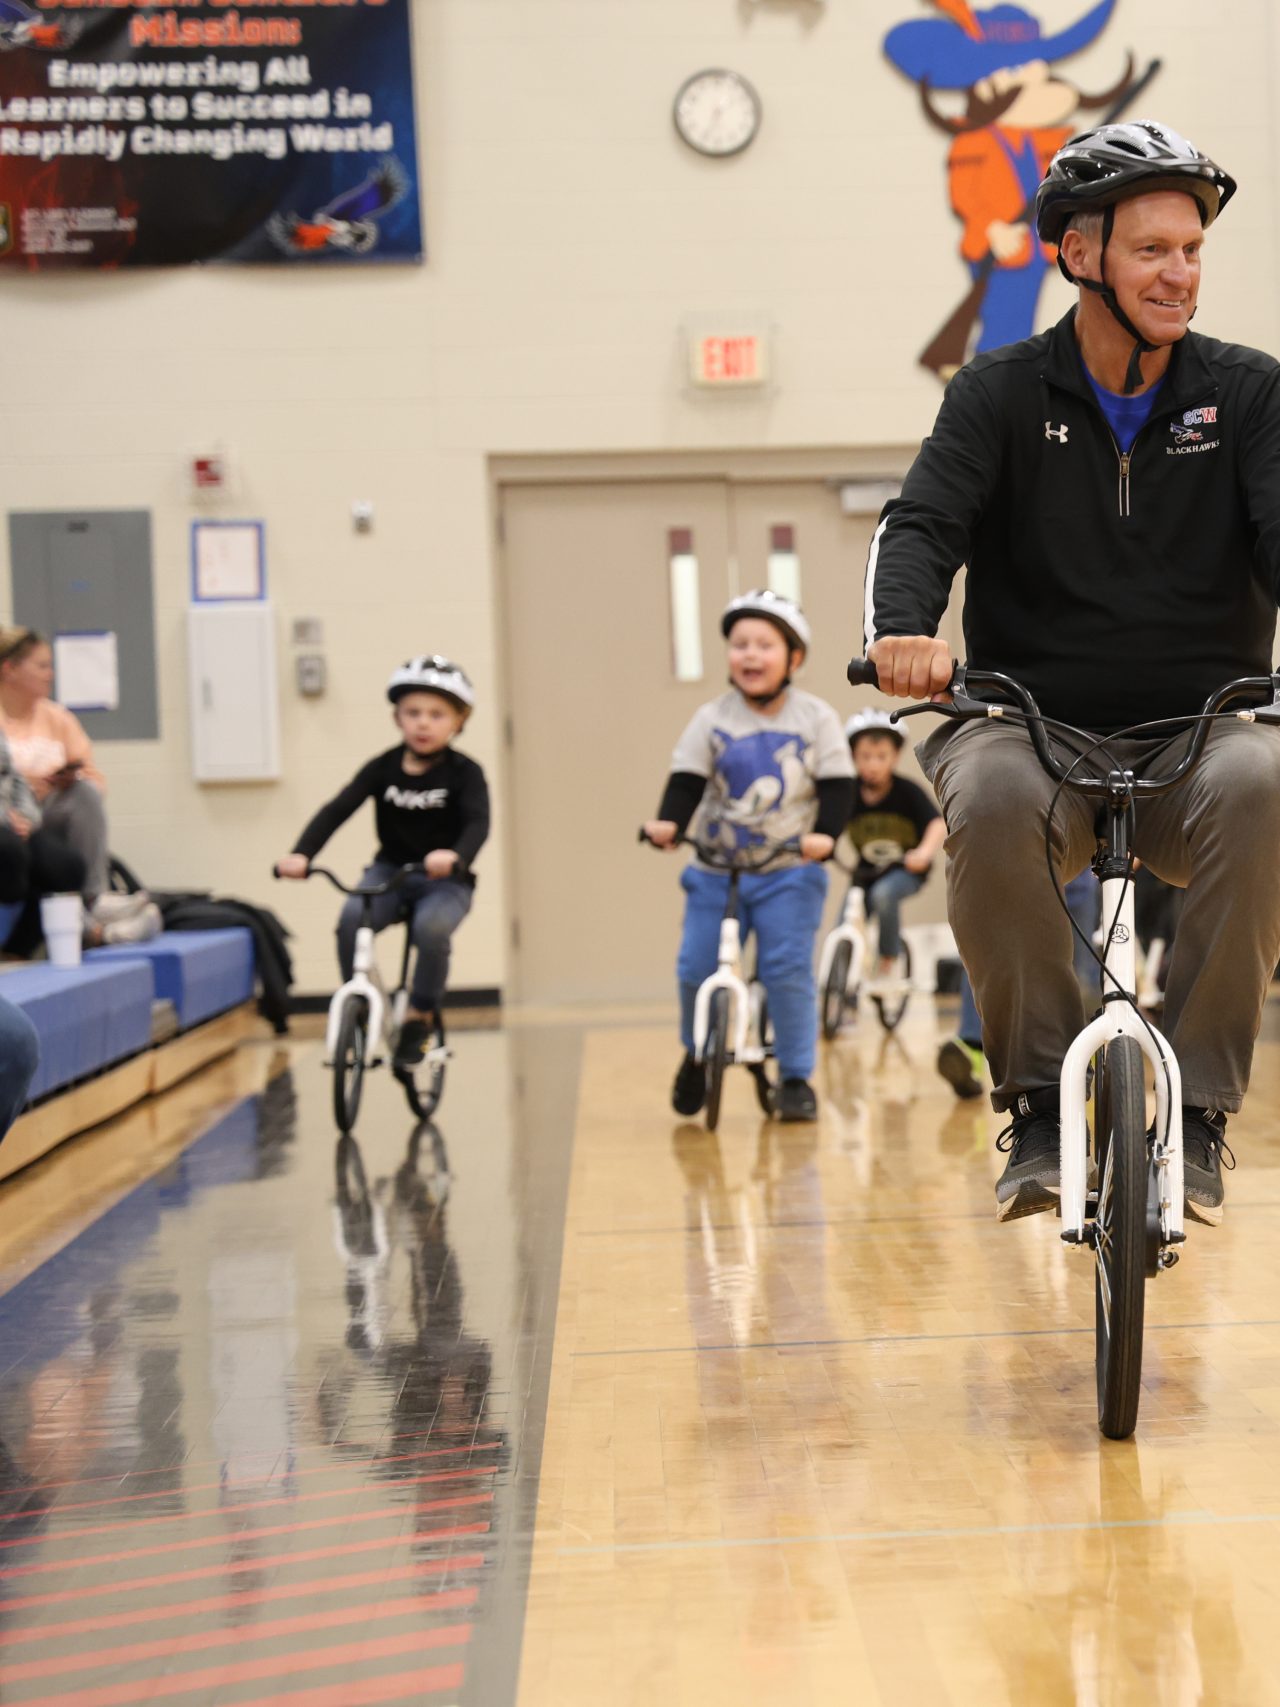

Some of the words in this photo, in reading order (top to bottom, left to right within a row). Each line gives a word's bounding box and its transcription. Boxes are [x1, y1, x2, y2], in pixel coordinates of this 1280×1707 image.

[129, 10, 302, 47] Mission:
[48, 55, 260, 92] Empowering
[263, 55, 312, 86] All
[151, 94, 188, 120] to
[192, 90, 330, 120] Succeed
[334, 87, 372, 118] in
[0, 123, 126, 162] Rapidly
[131, 122, 288, 160] Changing
[290, 121, 393, 152] World
[1183, 407, 1217, 425] SCW
[1166, 439, 1220, 455] BLACKHAWKS
[383, 785, 449, 809] NIKE
